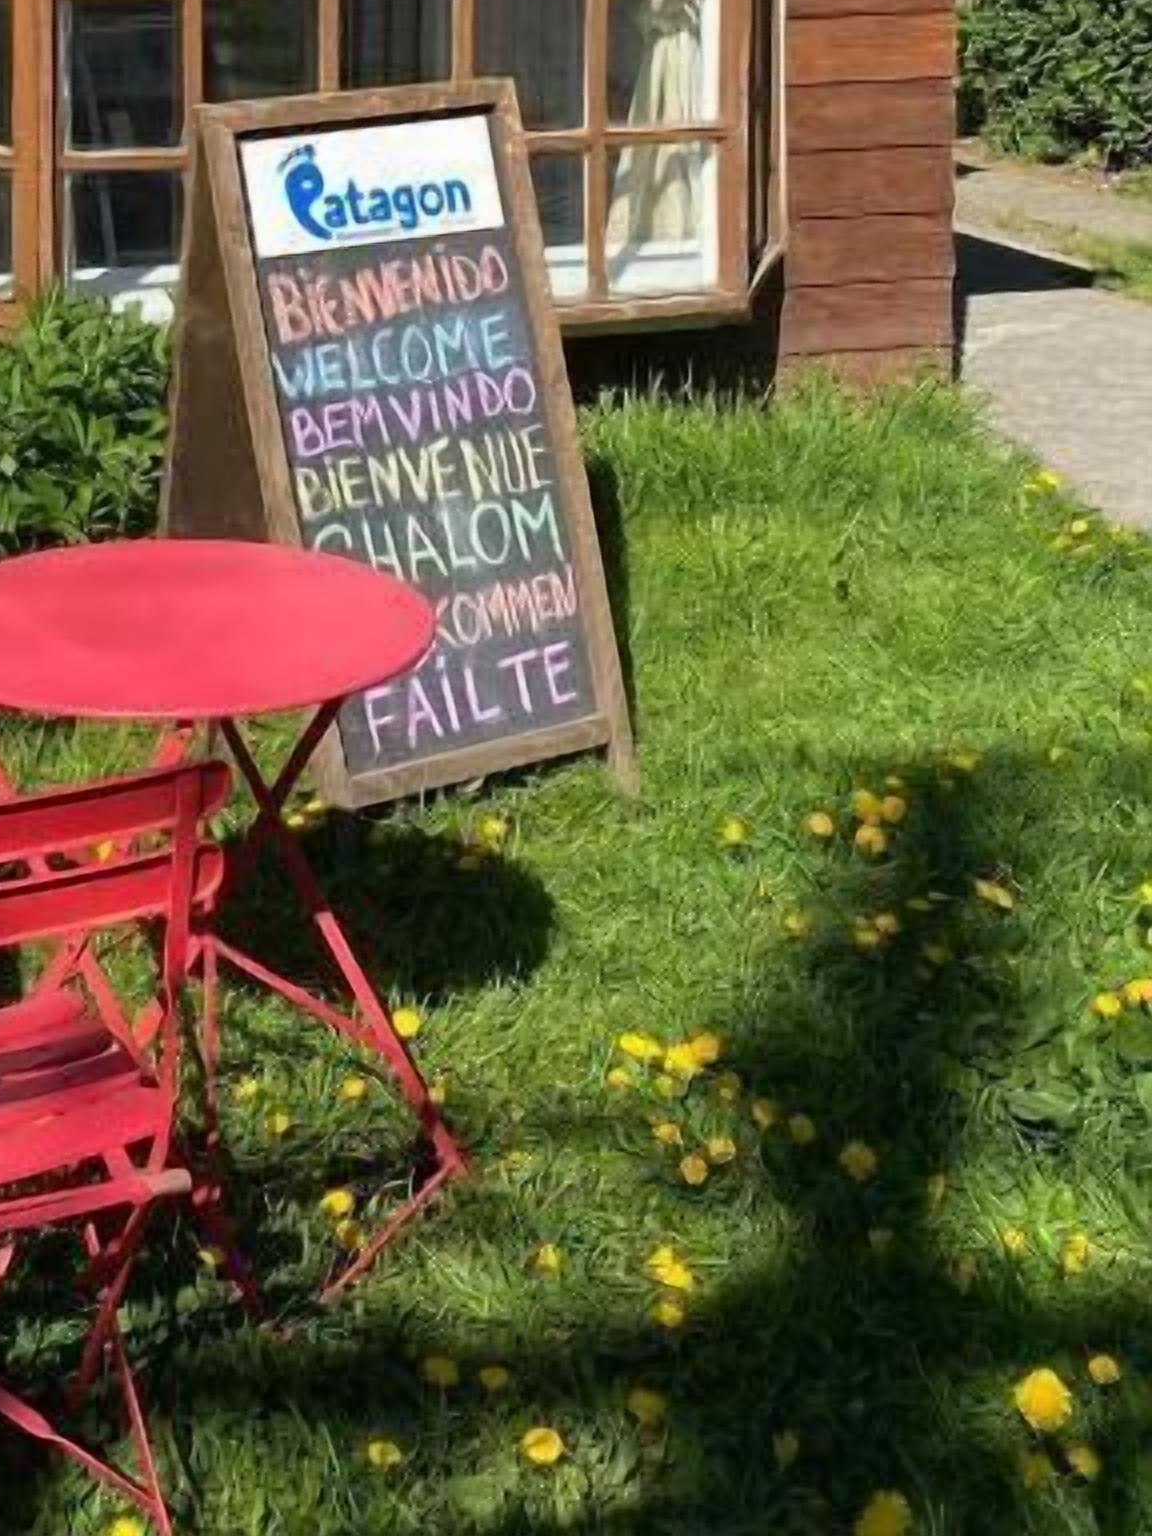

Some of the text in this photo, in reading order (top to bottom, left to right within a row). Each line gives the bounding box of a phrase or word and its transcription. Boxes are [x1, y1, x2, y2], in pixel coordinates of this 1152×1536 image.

[285, 163, 471, 239] Patagon
[272, 314, 515, 397] WELCOME
[296, 425, 552, 521] BIENVENUE
